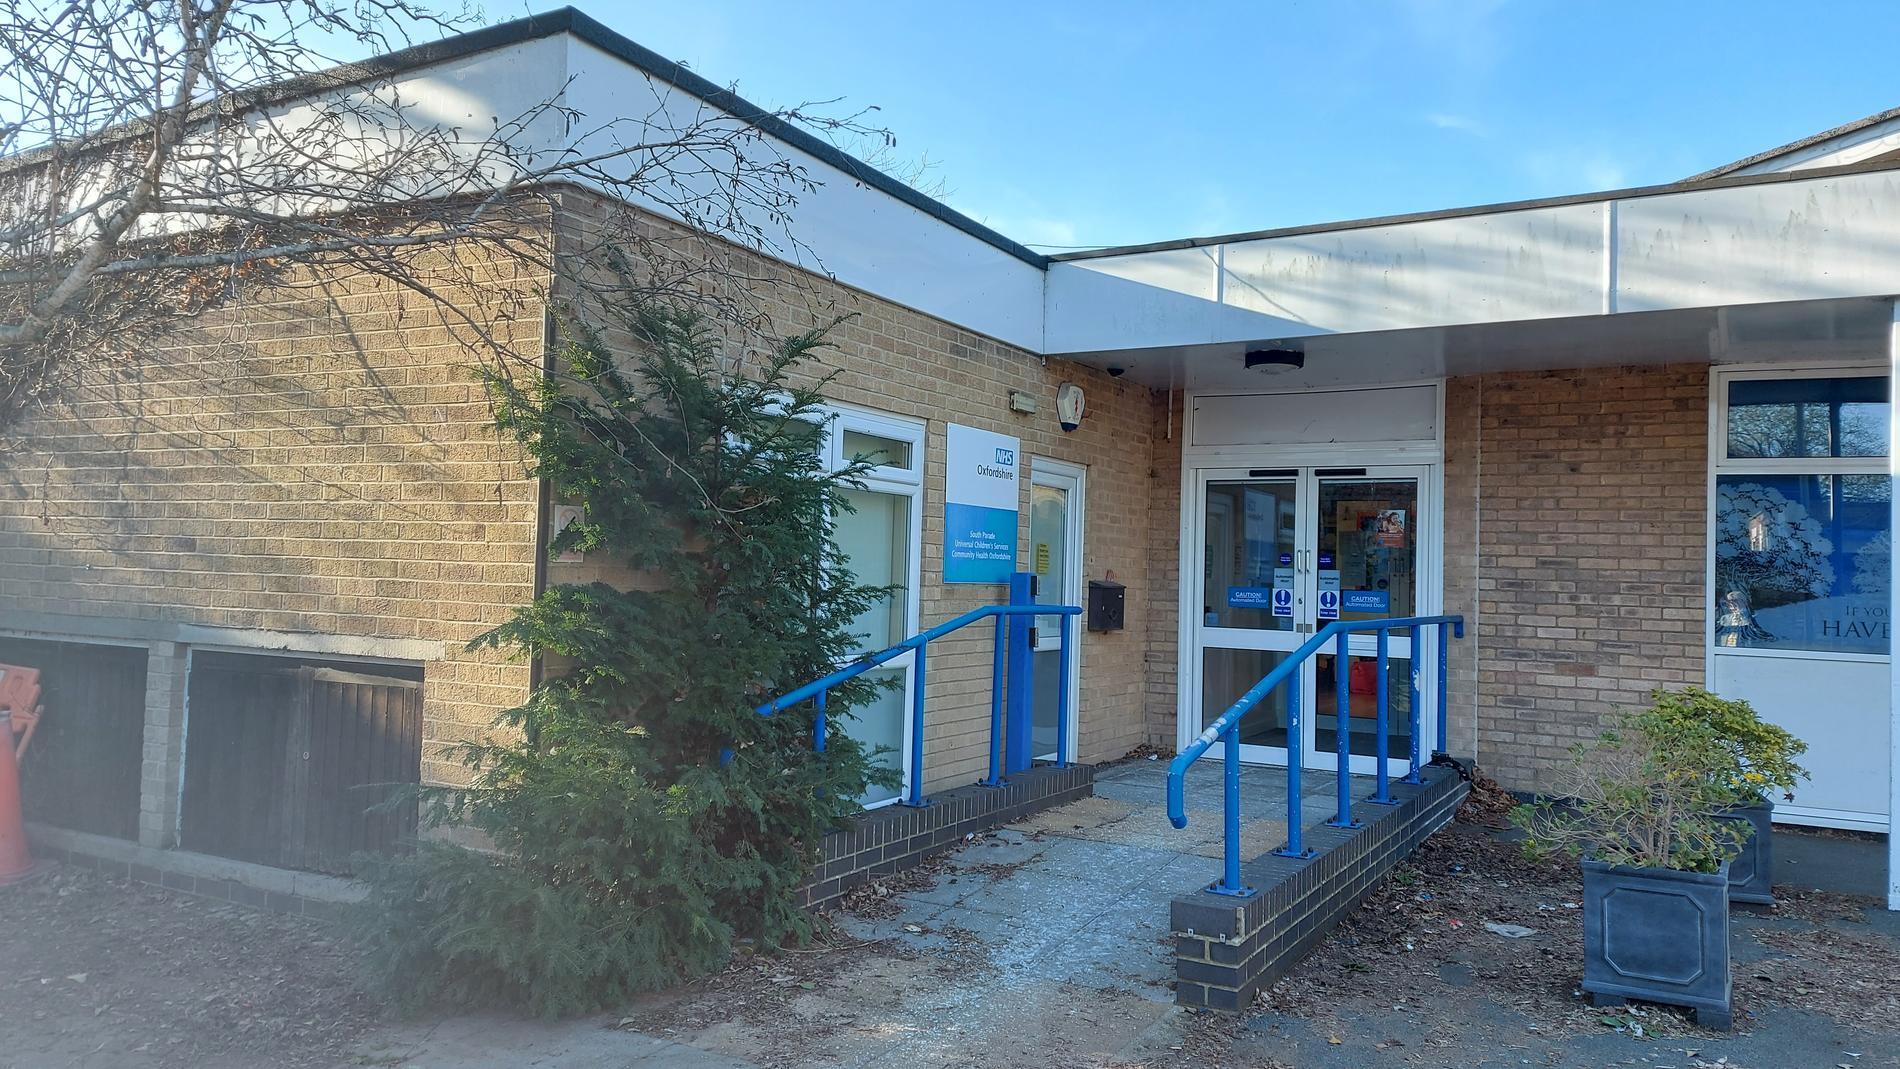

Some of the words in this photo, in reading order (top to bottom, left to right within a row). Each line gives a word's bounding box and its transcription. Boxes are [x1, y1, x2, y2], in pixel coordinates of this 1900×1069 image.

[996, 449, 1013, 465] NHS
[978, 464, 1014, 480] Oxfordshire
[969, 529, 982, 539] South
[982, 531, 996, 540] Parade
[954, 540, 974, 549] Universal
[974, 541, 994, 550] Children's
[993, 543, 1009, 551] Services
[951, 550, 976, 561] Community
[975, 552, 989, 560] Health
[988, 553, 1012, 561] Oxfordshire
